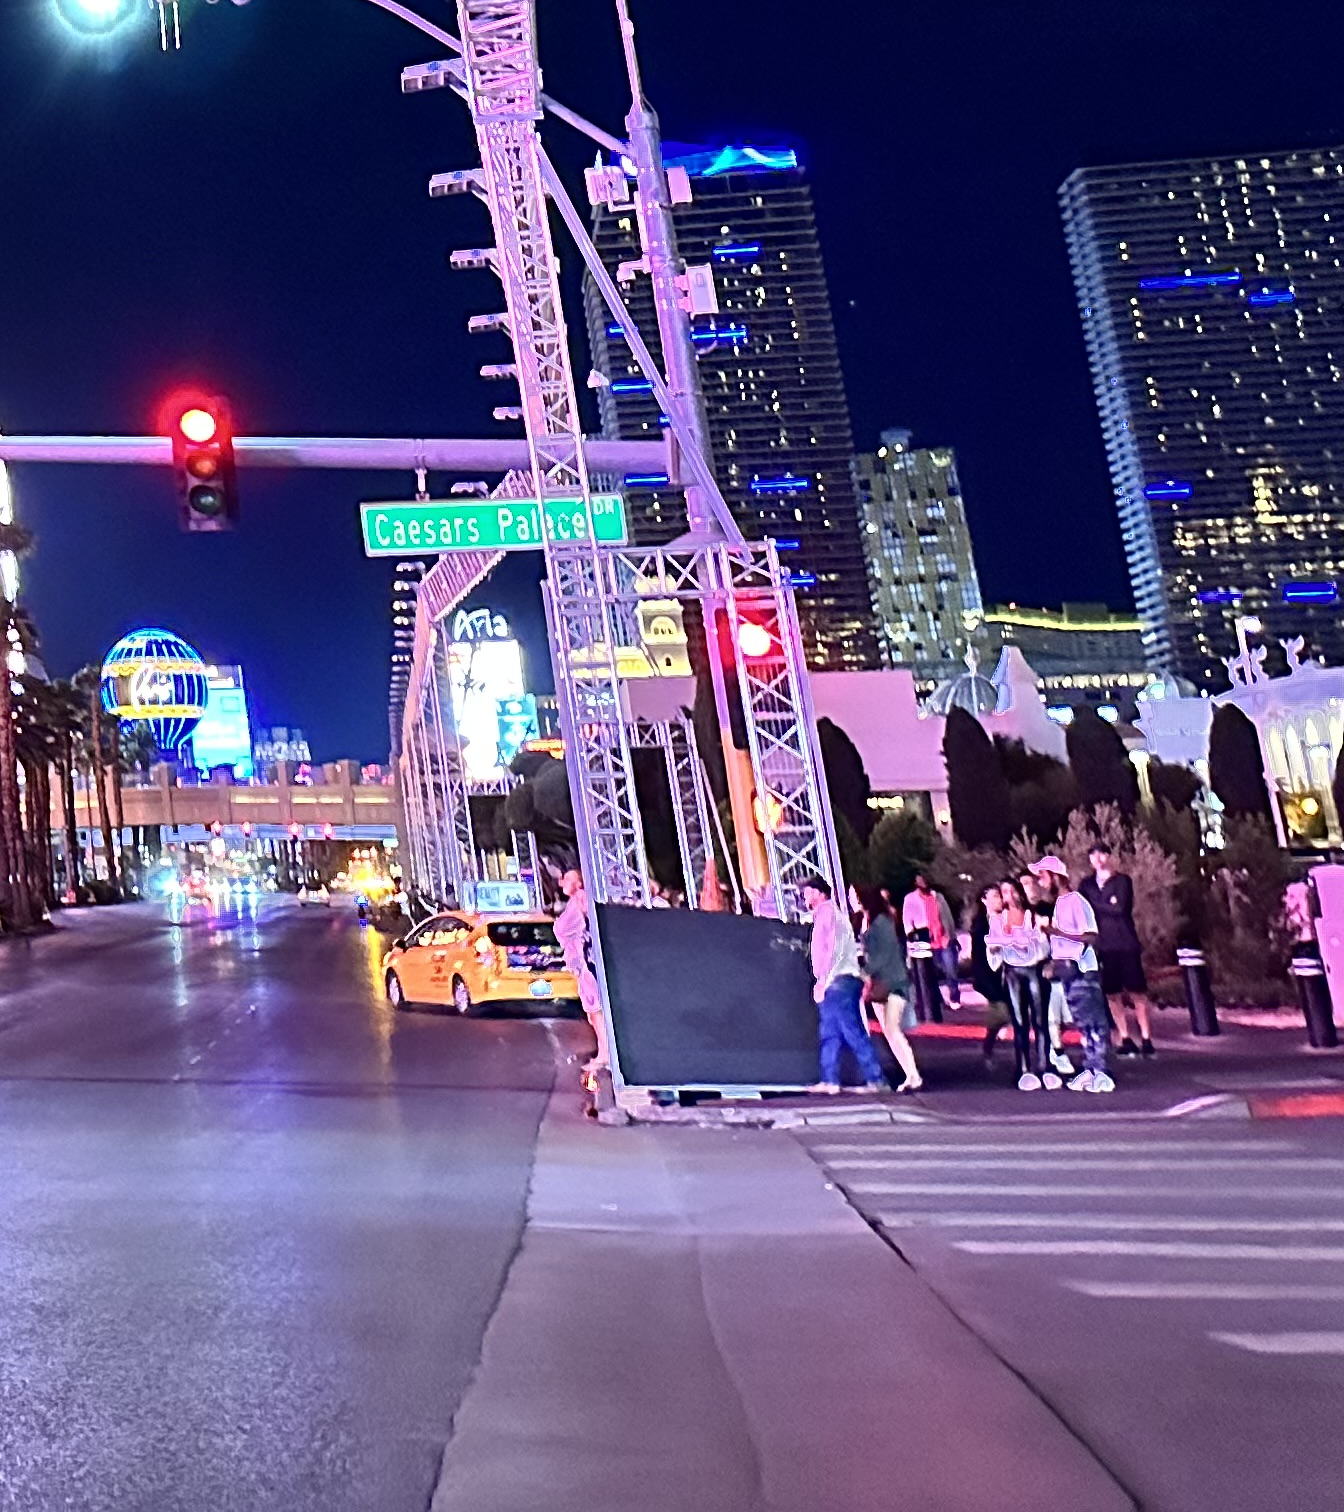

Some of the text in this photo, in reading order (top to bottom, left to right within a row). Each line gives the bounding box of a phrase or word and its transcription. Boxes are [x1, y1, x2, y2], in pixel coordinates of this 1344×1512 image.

[375, 498, 615, 547] Caesars Palace DR
[453, 608, 509, 641] Aria
